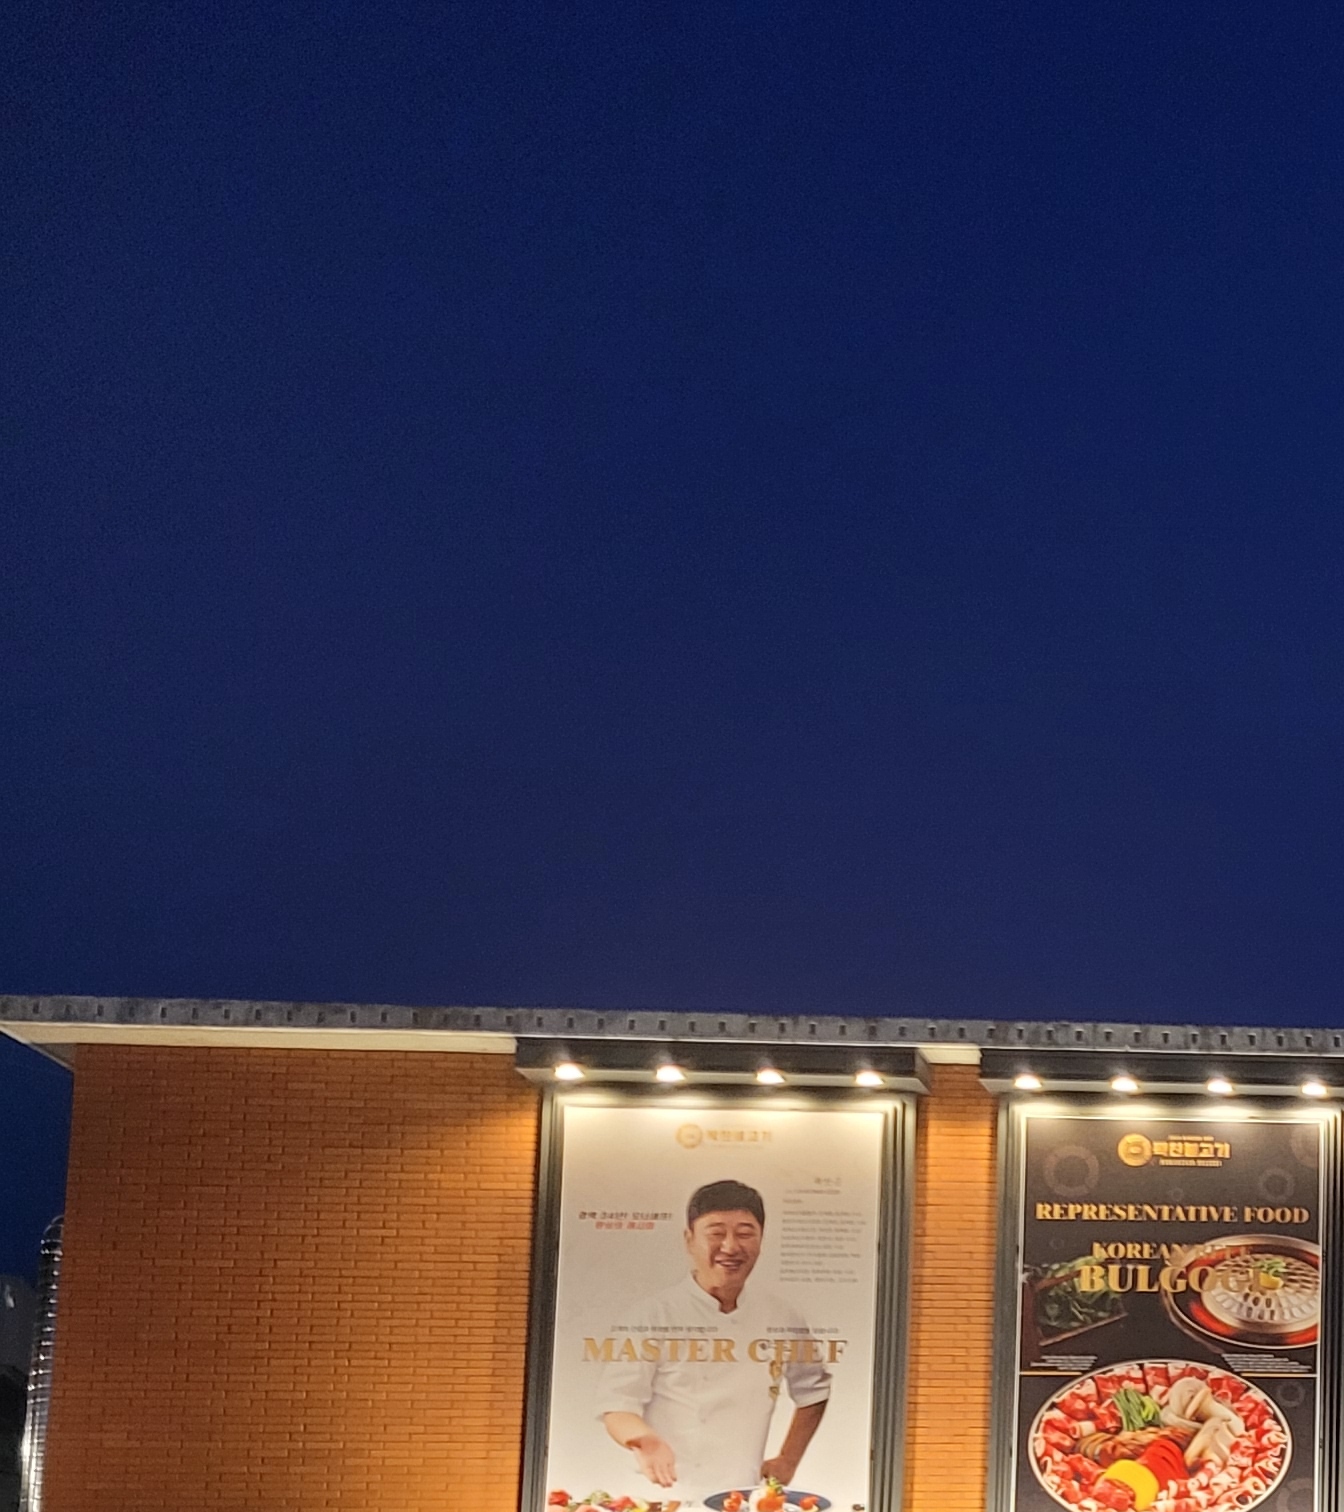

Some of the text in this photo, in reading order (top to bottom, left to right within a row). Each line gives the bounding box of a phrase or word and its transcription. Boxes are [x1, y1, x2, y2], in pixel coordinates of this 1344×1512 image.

[1035, 1202, 1309, 1225] REPRESENTATIVE FOOD
[1092, 1241, 1184, 1260] KOREAN
[582, 1337, 848, 1363] MASTER CHEF
